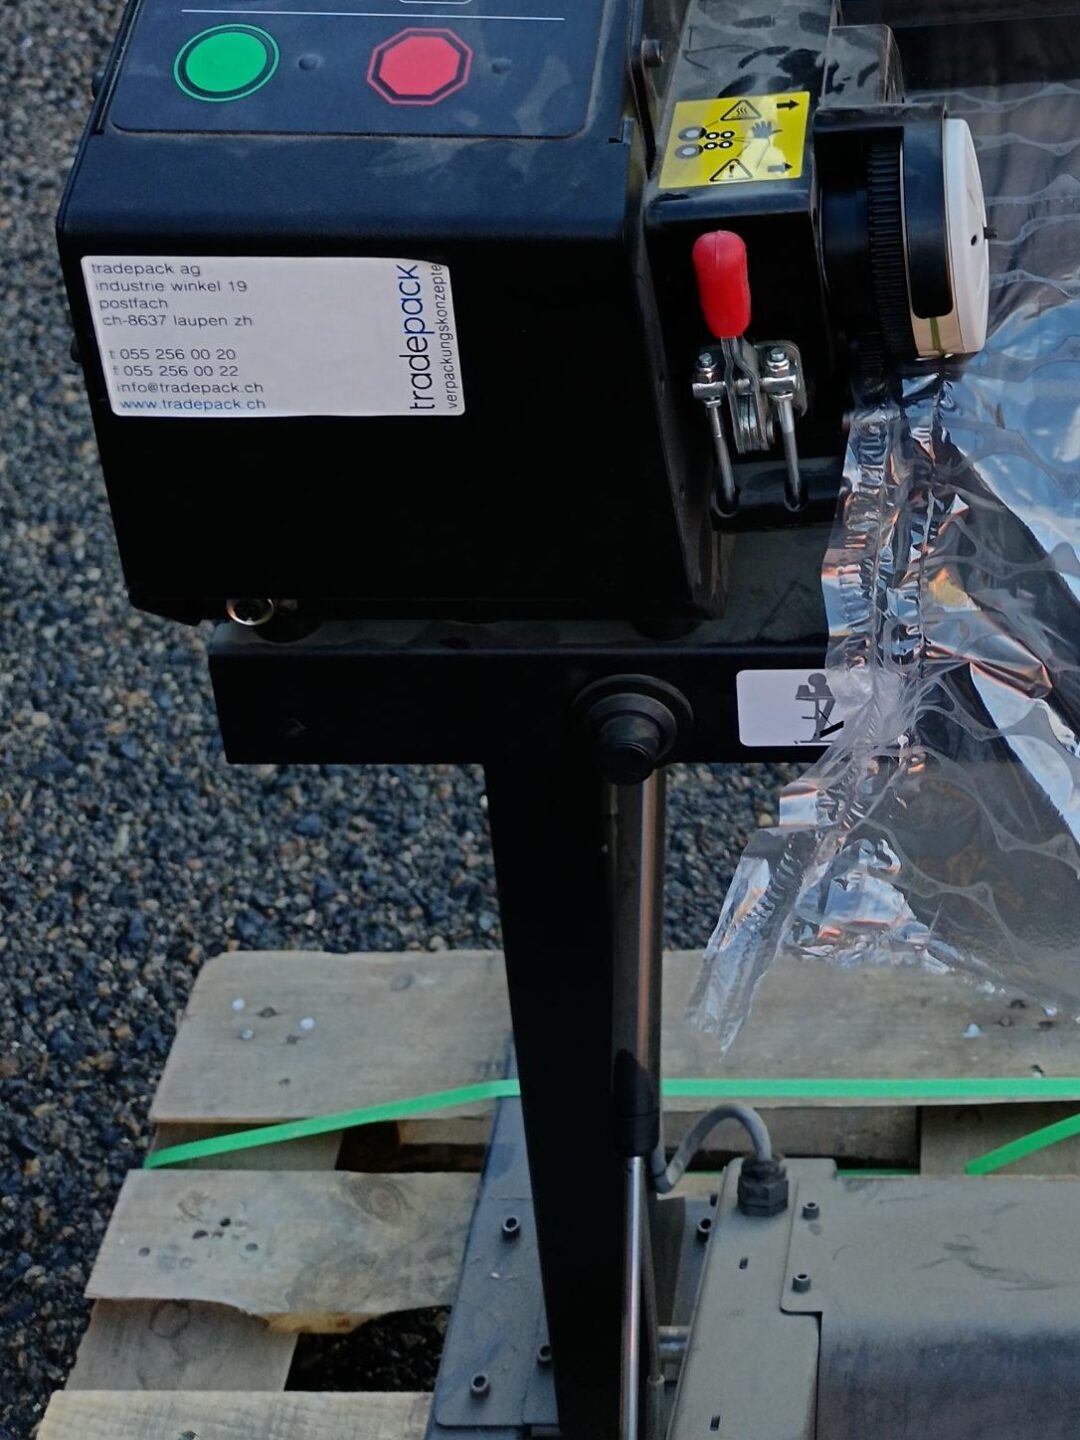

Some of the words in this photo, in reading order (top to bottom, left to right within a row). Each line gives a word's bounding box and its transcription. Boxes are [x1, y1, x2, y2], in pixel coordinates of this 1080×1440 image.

[91, 263, 174, 275] tradepack
[180, 265, 201, 277] ag
[95, 280, 165, 292] industrie
[170, 280, 221, 292] winkel
[228, 281, 248, 292] 19
[99, 297, 168, 310] postfach
[102, 315, 166, 326] ch-8637
[174, 315, 228, 329] laupen
[234, 316, 253, 326] zh
[396, 264, 435, 410] tradepack
[430, 264, 459, 409] verpackungskonzepte
[120, 348, 150, 360] 055
[155, 348, 185, 360] 256
[190, 348, 211, 360] 00
[216, 348, 236, 360] 20
[123, 365, 153, 377] 055
[158, 365, 188, 377] 256
[193, 365, 214, 377] 00
[219, 365, 239, 377] 22
[116, 381, 264, 395] info@tradepack.ch
[120, 398, 266, 412] www.tradepack.ch
